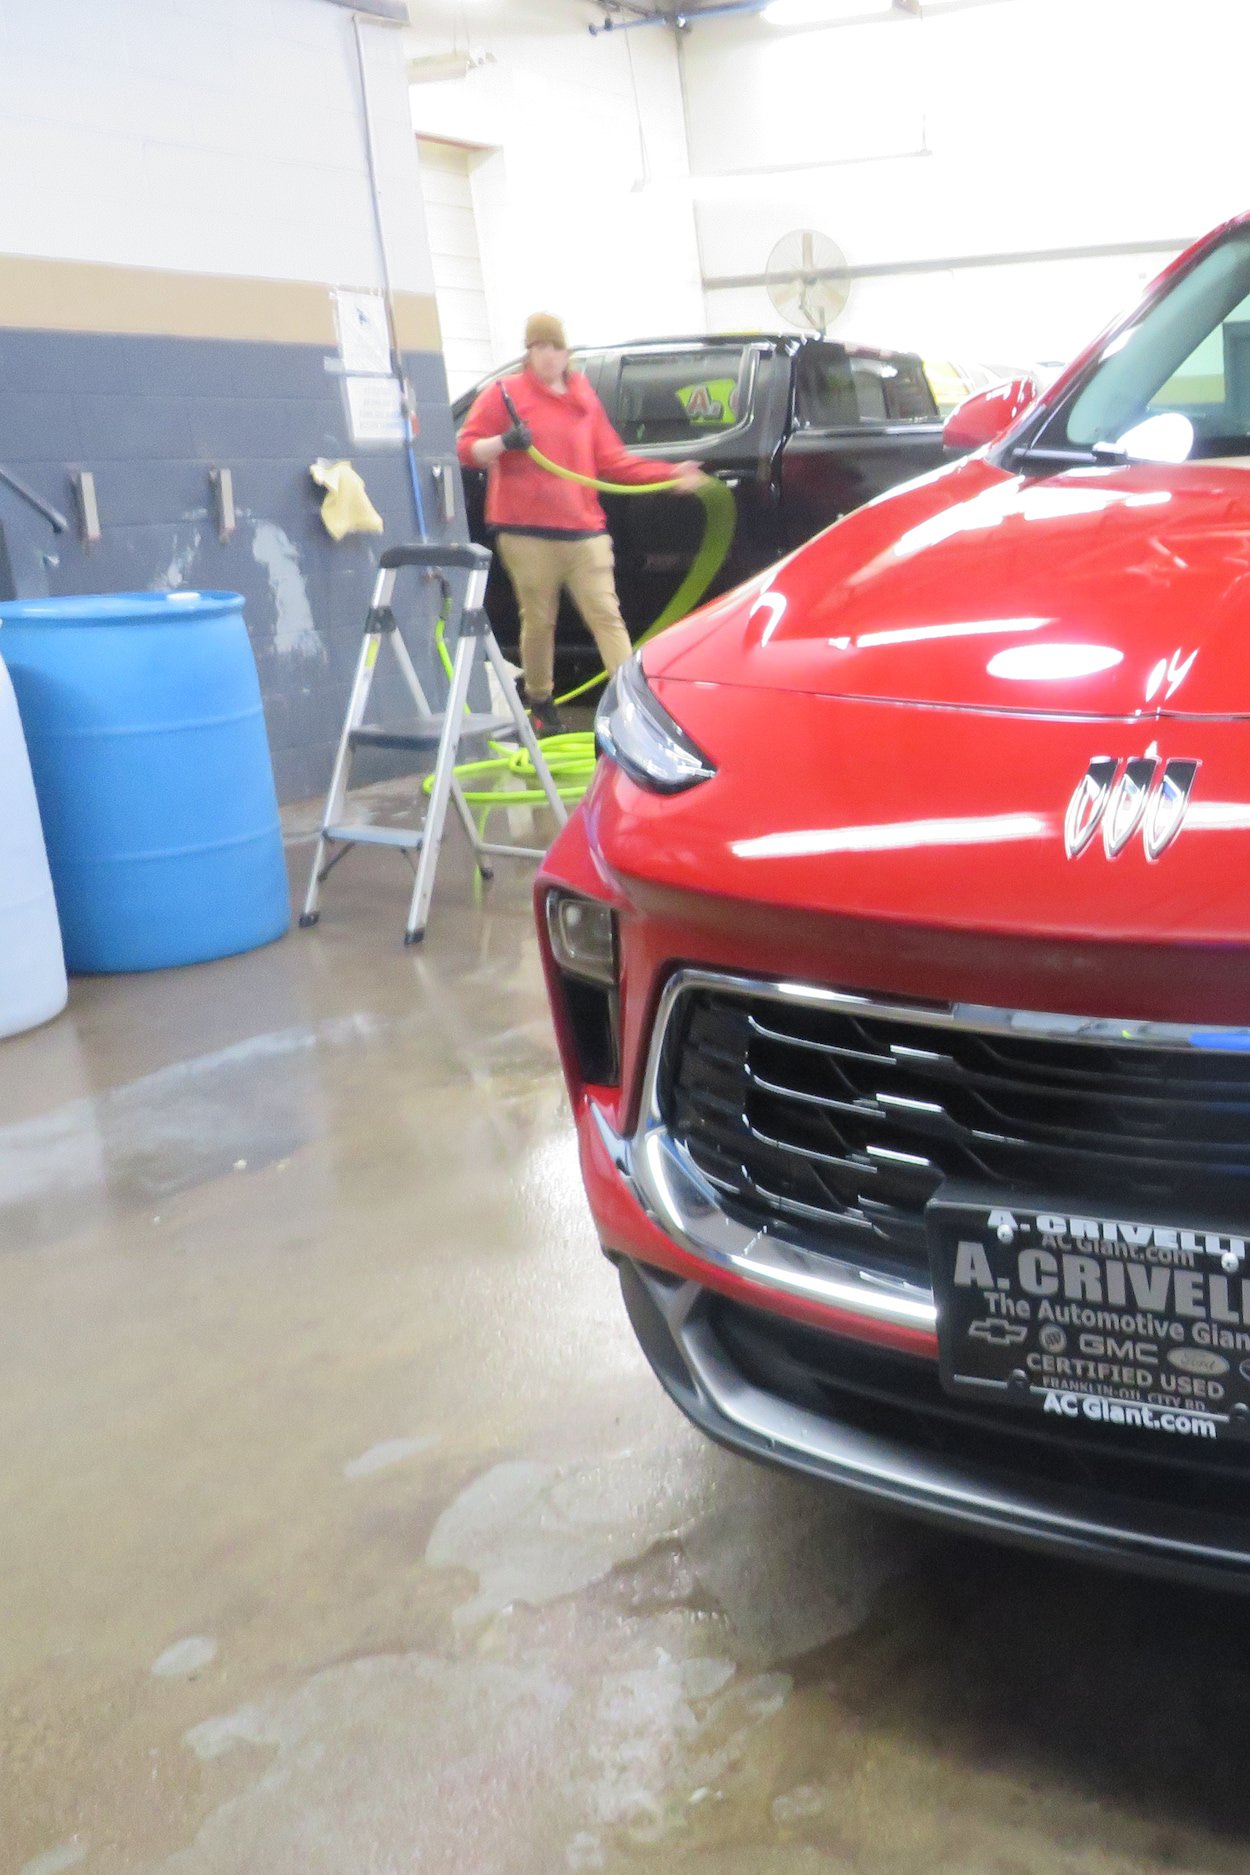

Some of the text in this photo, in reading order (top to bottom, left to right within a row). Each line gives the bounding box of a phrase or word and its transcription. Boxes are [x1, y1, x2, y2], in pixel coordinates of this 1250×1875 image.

[1036, 1214, 1245, 1260] CRIVELLI
[954, 1241, 1011, 1291] A.
[983, 1291, 1031, 1321] The
[1037, 1299, 1185, 1343] Automotive
[1079, 1333, 1159, 1365] GMC
[1026, 1352, 1226, 1400] CERTIFIED USED
